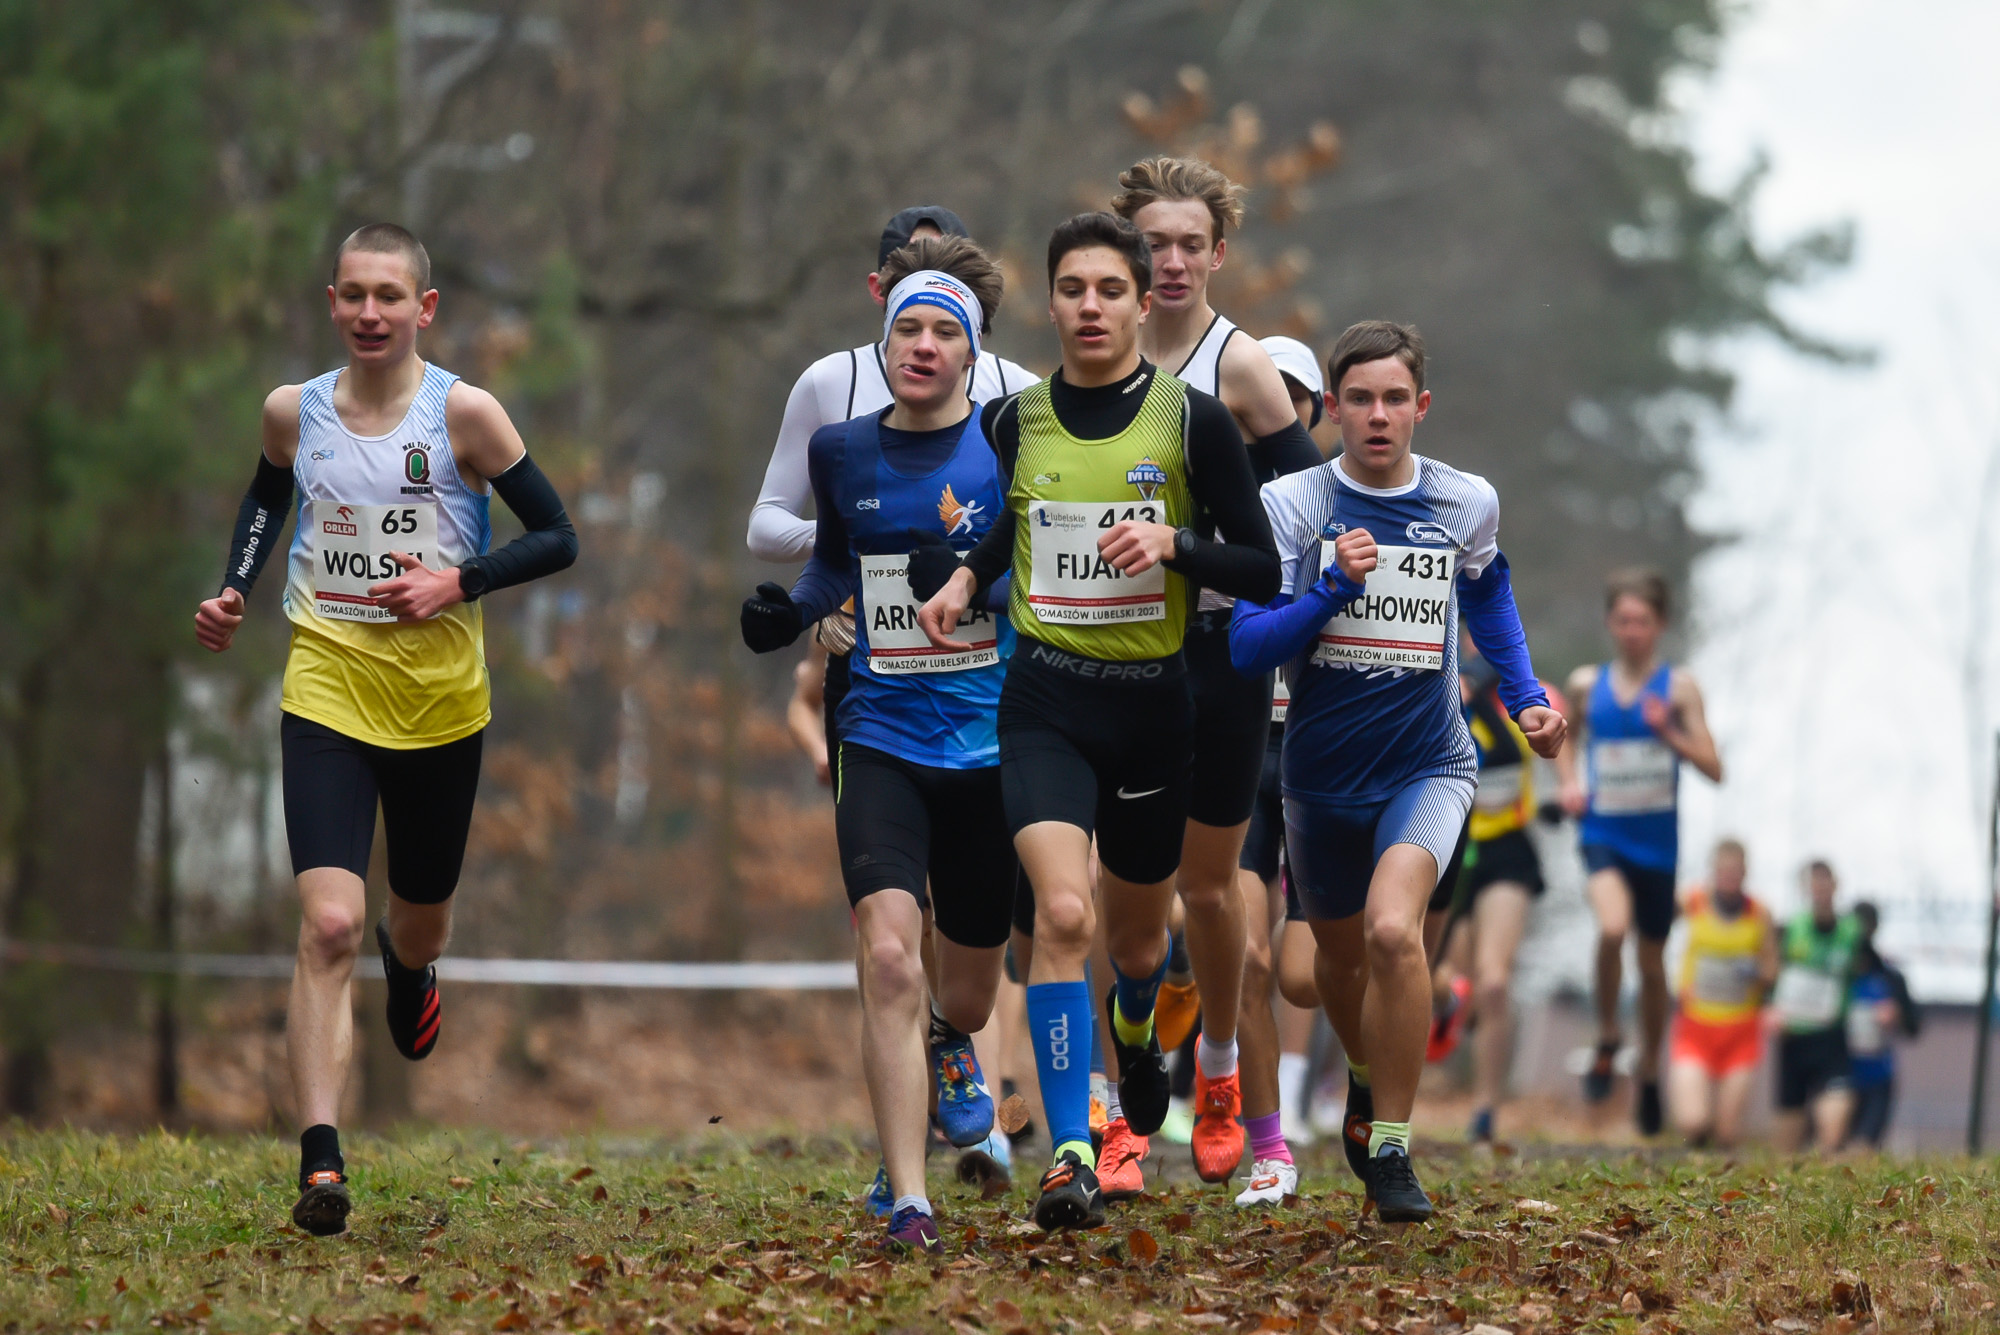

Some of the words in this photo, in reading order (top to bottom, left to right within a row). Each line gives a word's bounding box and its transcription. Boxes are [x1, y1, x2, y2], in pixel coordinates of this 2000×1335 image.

[1034, 472, 1061, 485] esa
[1127, 471, 1166, 483] MKS
[400, 485, 434, 495] MOGILNO
[856, 498, 880, 510] esa
[381, 508, 418, 535] 65
[1050, 512, 1086, 523] lubelskie
[324, 522, 356, 535] ORLEN
[236, 536, 260, 579] Mogilno
[867, 569, 884, 578] TVP
[886, 568, 909, 578] SPOR
[1056, 552, 1121, 580] FIJA
[1398, 552, 1449, 581] 431
[320, 603, 366, 618] TOMASZÓW
[1034, 607, 1089, 620] TOMASZÓW
[1092, 606, 1135, 620] LUBELSKI
[1137, 606, 1160, 617] 2021
[878, 657, 927, 670] TOMASZÓW
[929, 655, 970, 668] LUBELSKI
[970, 652, 994, 664] 2021
[1031, 645, 1100, 677] NIKE
[1101, 663, 1163, 680] PRO
[1324, 646, 1382, 660] TOMASZÓW
[1385, 652, 1425, 664] LUBELSKI
[1427, 655, 1441, 665] 202
